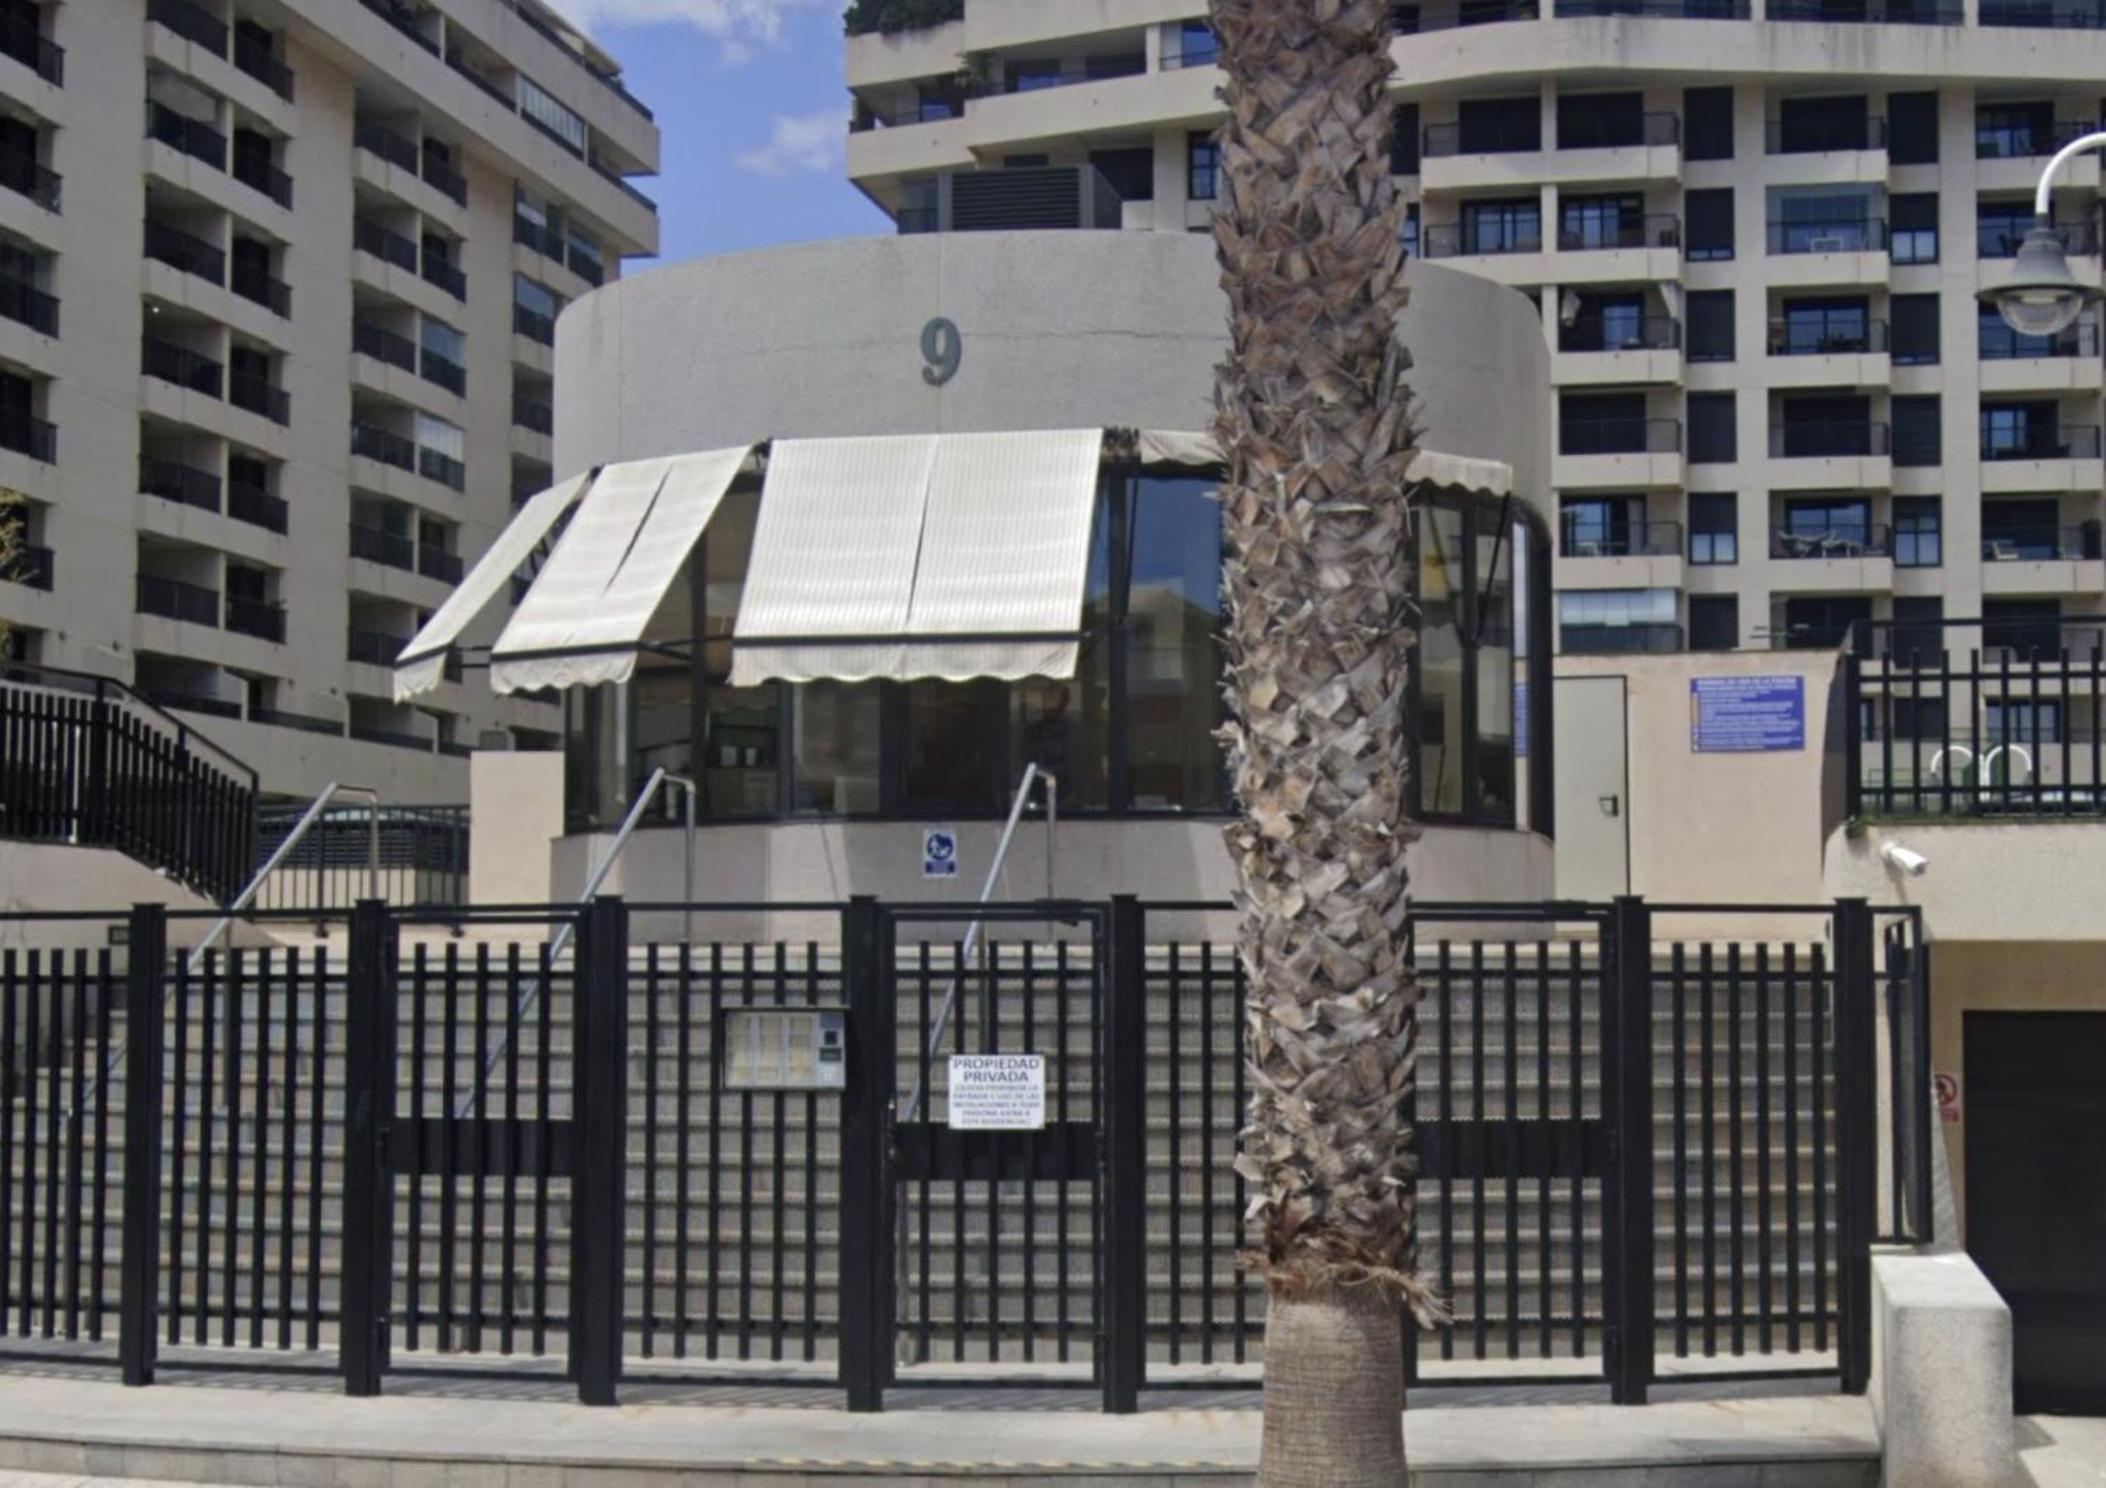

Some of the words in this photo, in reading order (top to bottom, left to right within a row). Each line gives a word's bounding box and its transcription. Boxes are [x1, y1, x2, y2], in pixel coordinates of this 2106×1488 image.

[920, 317, 962, 387] 9
[953, 1058, 1040, 1069] PROPIEDAD
[964, 1071, 1029, 1082] PRIVADA
